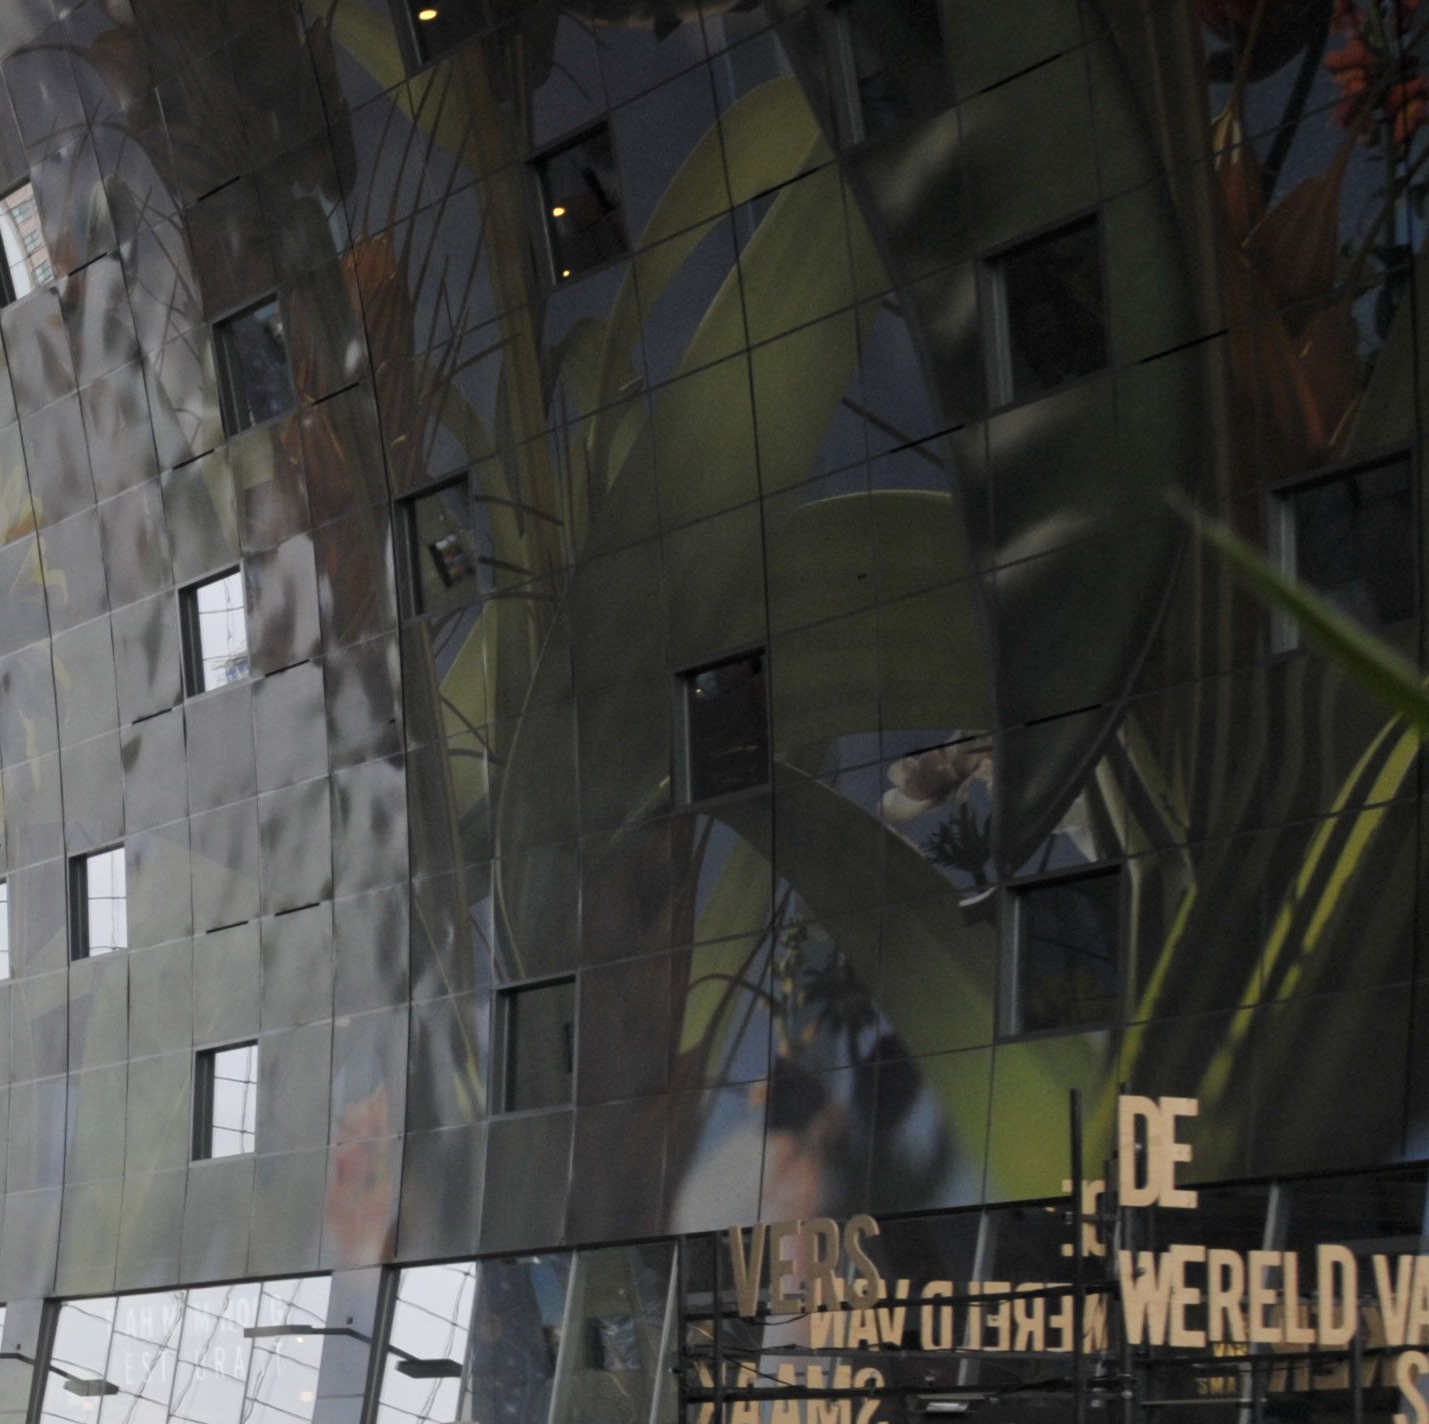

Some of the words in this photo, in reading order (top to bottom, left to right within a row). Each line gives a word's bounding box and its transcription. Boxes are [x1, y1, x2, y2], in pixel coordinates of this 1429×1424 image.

[1118, 1095, 1199, 1208] DE
[728, 1213, 880, 1317] VERS
[1118, 1244, 1357, 1348] WERELD
